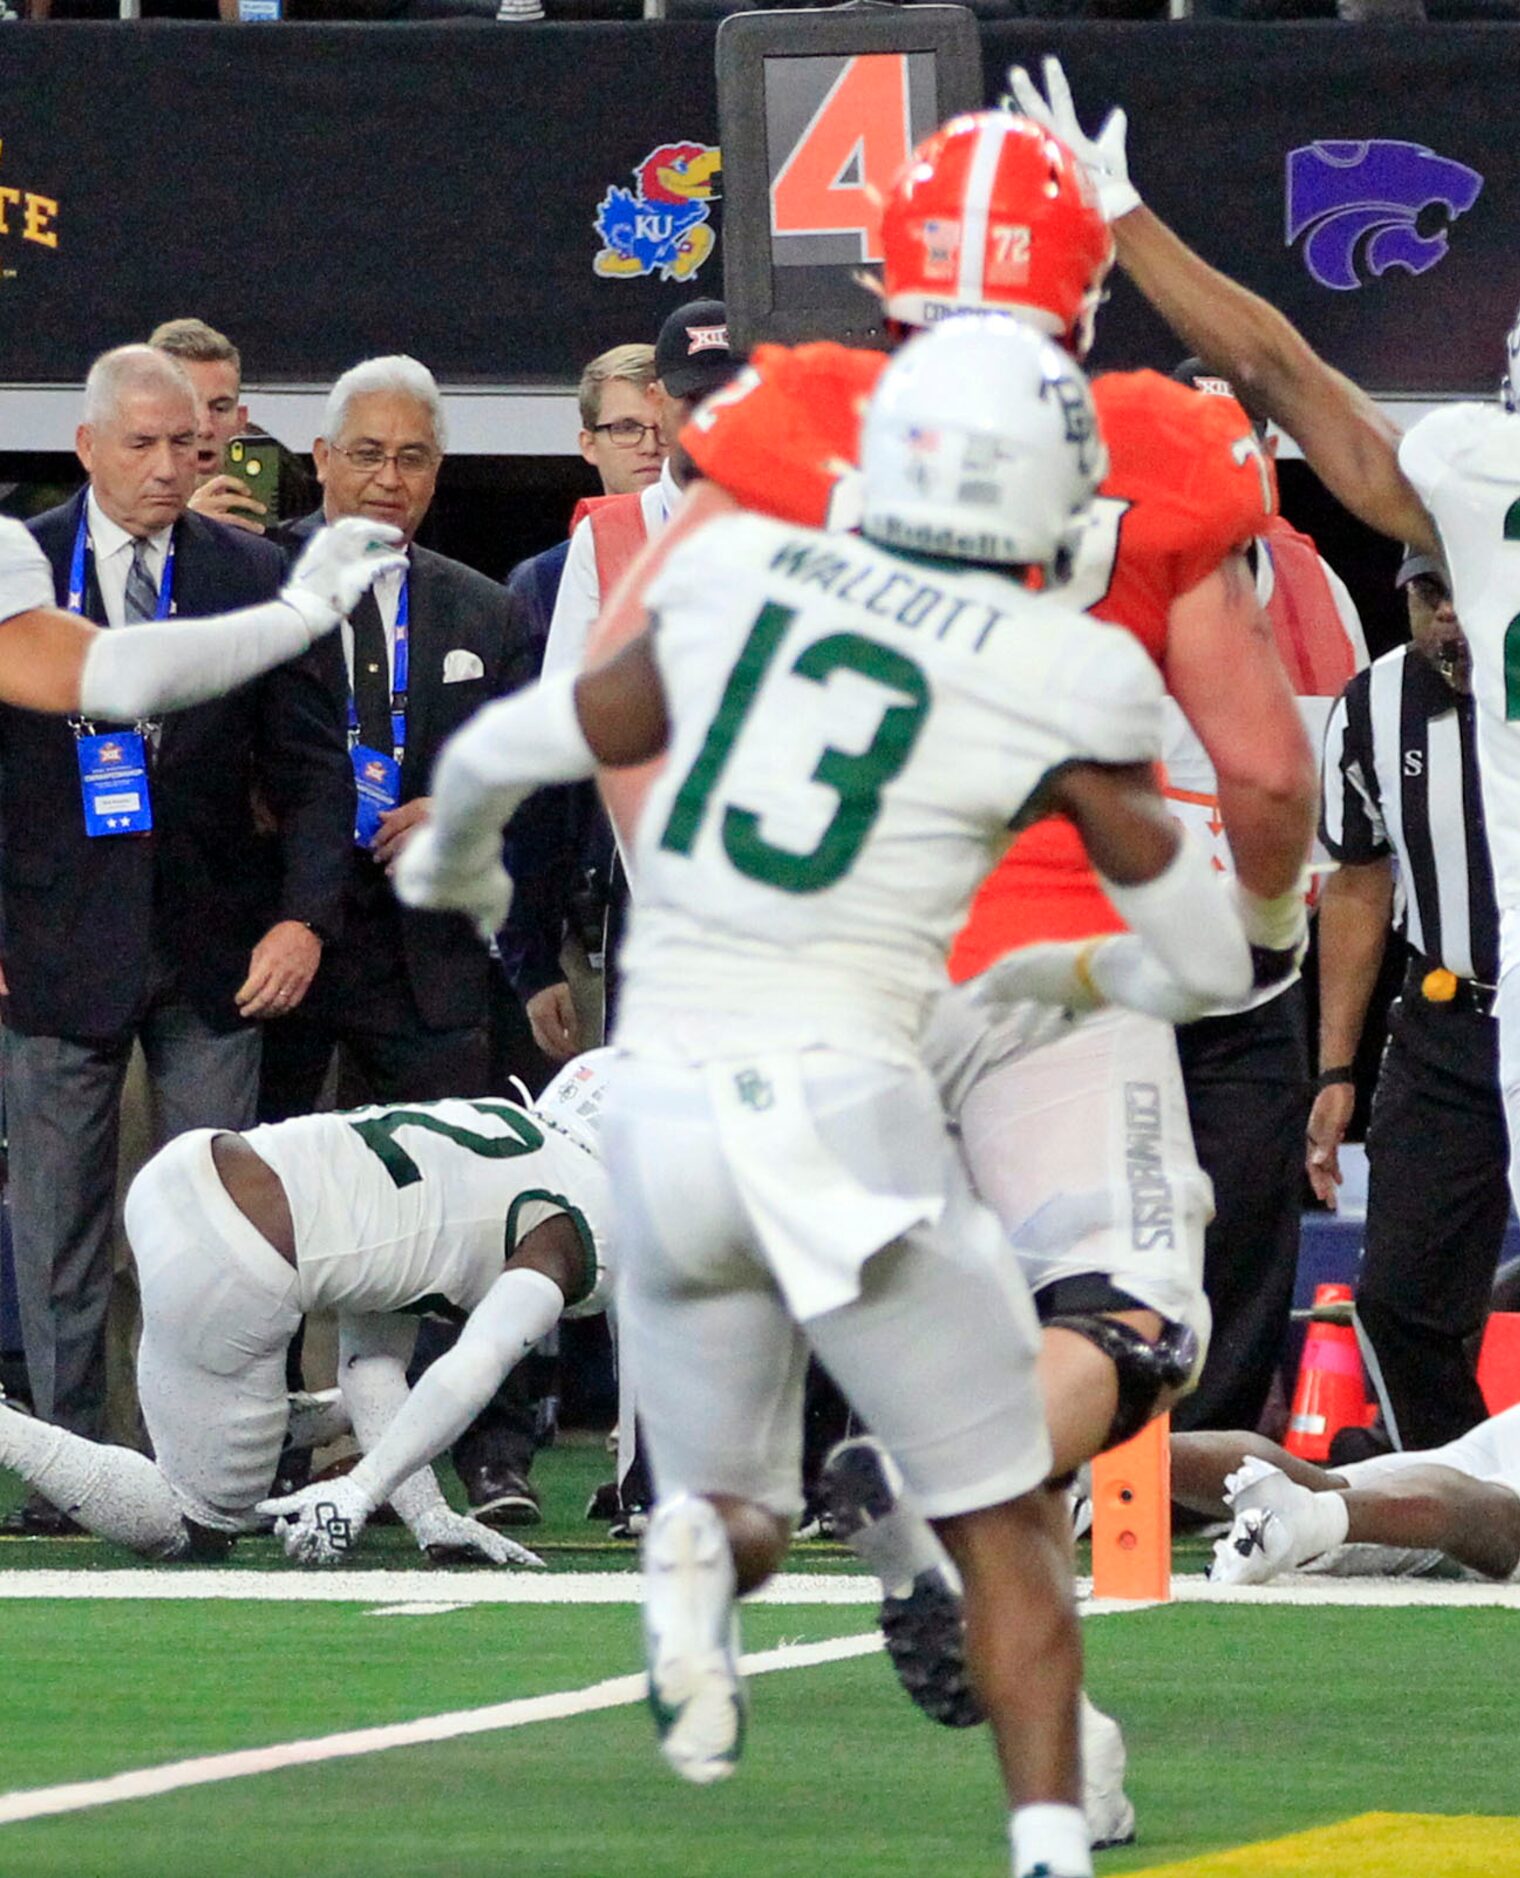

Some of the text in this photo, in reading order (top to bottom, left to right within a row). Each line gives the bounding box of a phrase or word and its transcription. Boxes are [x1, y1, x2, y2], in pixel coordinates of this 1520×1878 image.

[770, 53, 912, 263] 4
[634, 214, 673, 242] KU
[992, 224, 1031, 263] 72
[769, 541, 1007, 655] WALCOTT
[660, 597, 934, 895] 13
[1404, 750, 1423, 777] S
[1124, 1081, 1175, 1251] COWBOYS
